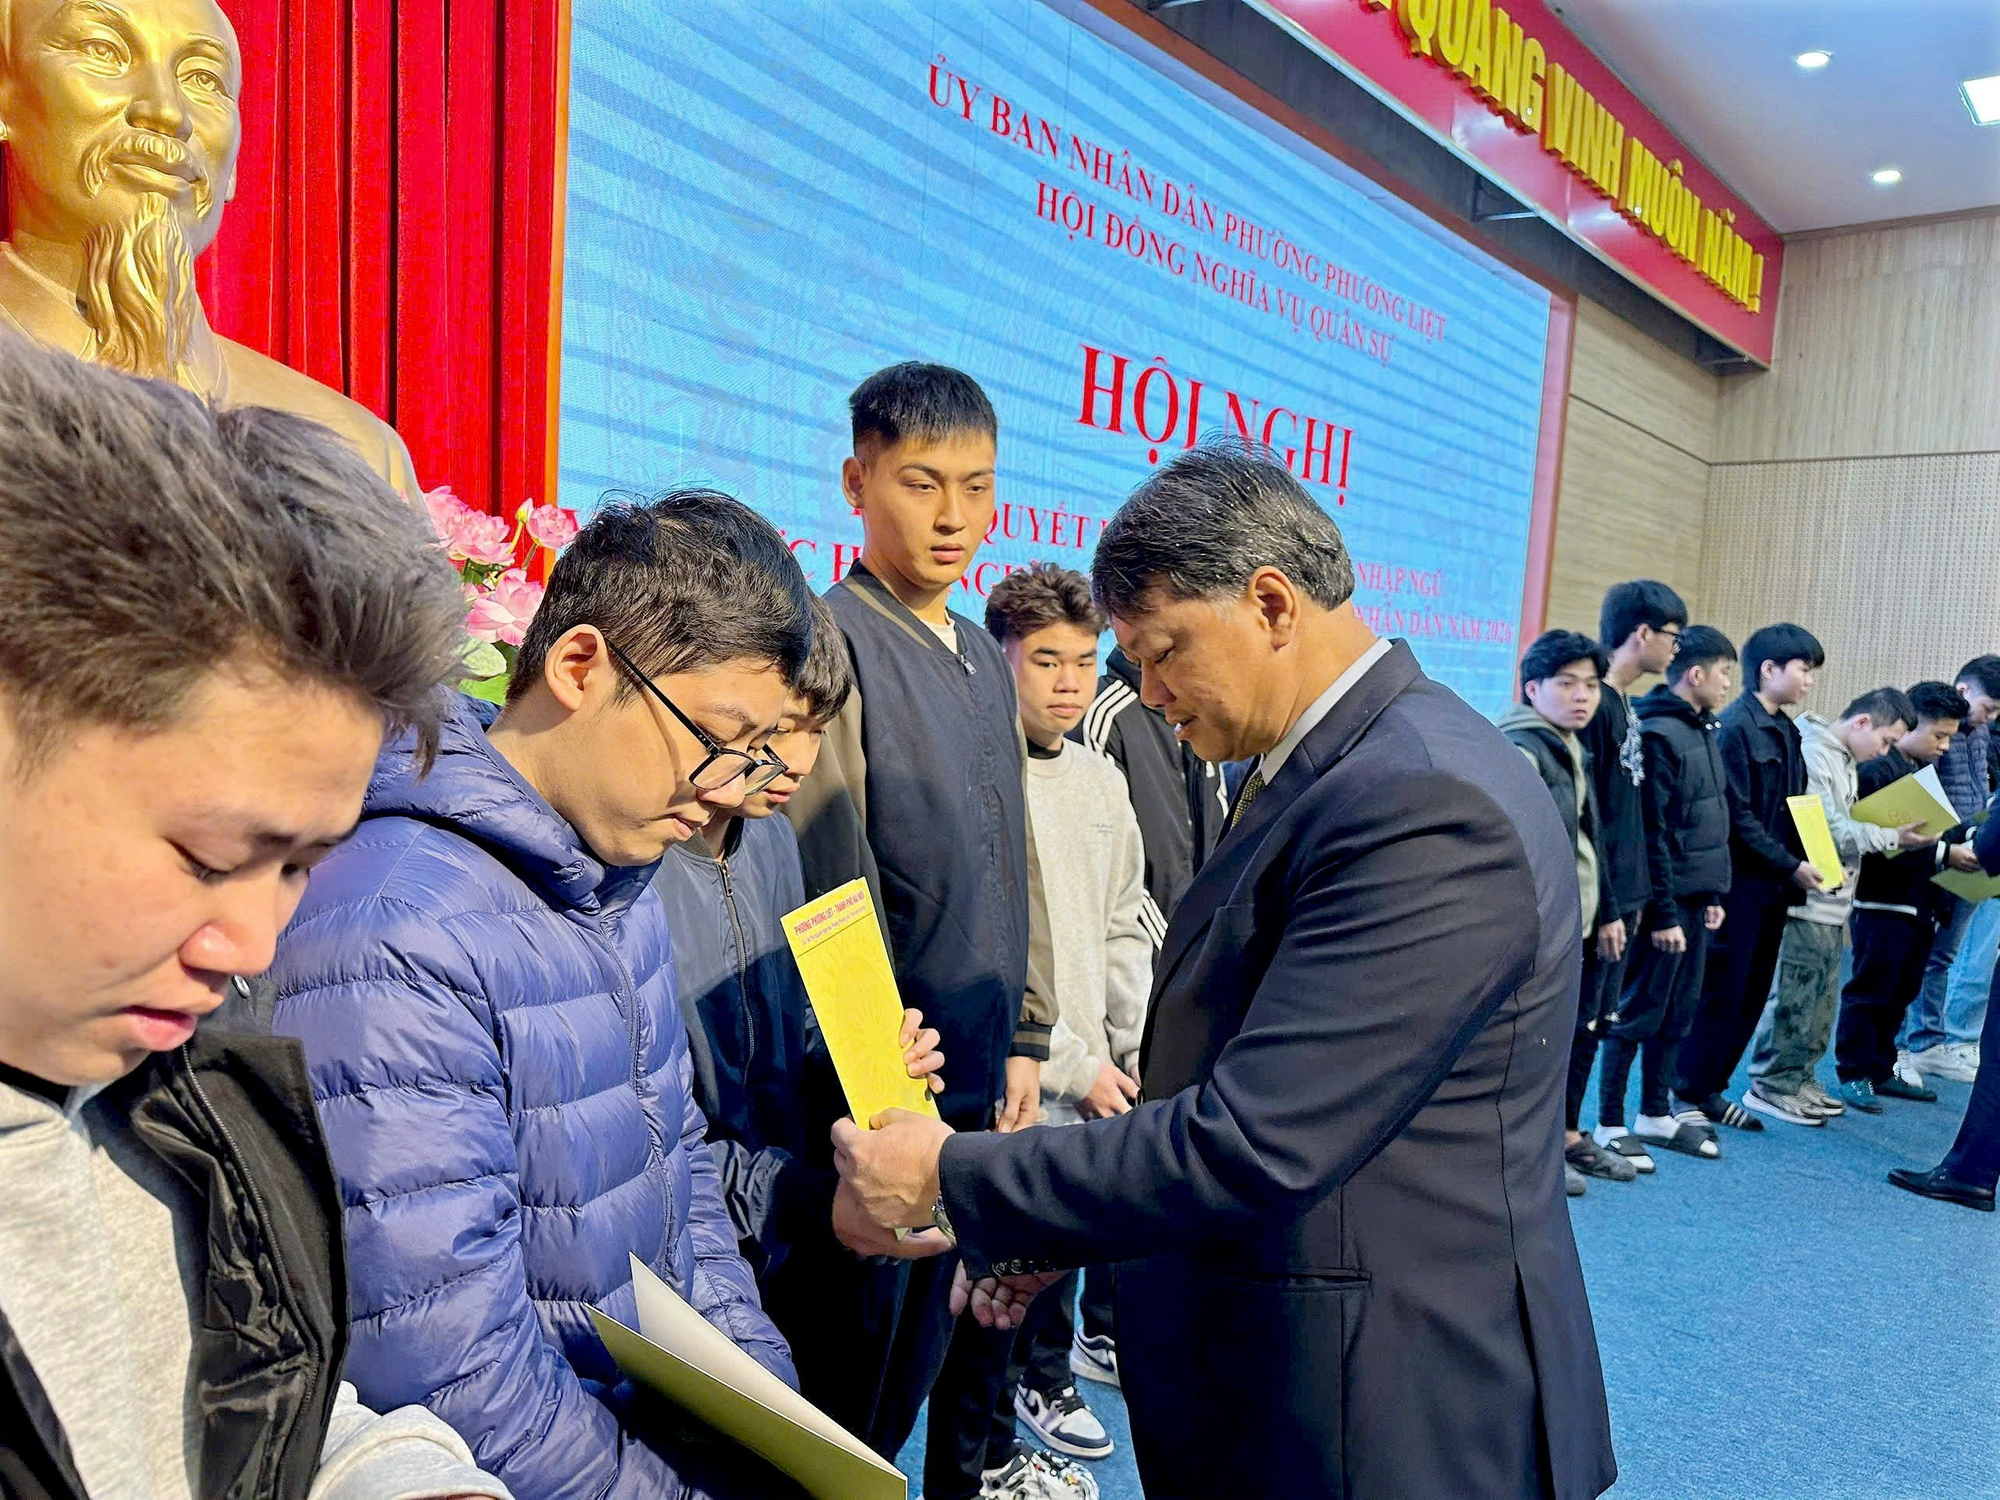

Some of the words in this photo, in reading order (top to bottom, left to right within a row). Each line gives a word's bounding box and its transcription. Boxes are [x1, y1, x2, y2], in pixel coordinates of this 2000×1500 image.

[928, 53, 981, 122] ỦY
[989, 94, 1061, 161] BAN
[1067, 132, 1155, 207] NHÂN
[1160, 179, 1217, 235] DÂN
[1223, 212, 1320, 284] PHƯỜNG
[1323, 262, 1406, 324] PHƯƠNG
[1407, 301, 1447, 345] LIỆT
[1405, 0, 1546, 134] QUANG
[1548, 62, 1625, 199] VINH
[1624, 136, 1701, 264] MUÔN
[1698, 207, 1764, 314] NĂM!
[1035, 179, 1096, 242] HỘI
[1105, 212, 1186, 275] ĐỒNG
[1192, 250, 1270, 314] NGHĨA
[1276, 287, 1305, 334] VỤ
[1310, 305, 1367, 353] QUÂN
[1369, 329, 1396, 368] SỰ
[1074, 343, 1205, 465] HỘI
[1223, 389, 1355, 507] NGHỊ
[1355, 561, 1406, 597] NHẬP
[1406, 567, 1445, 598] NGŨ
[1408, 604, 1448, 638] DÂN
[1448, 611, 1482, 641] NĂM
